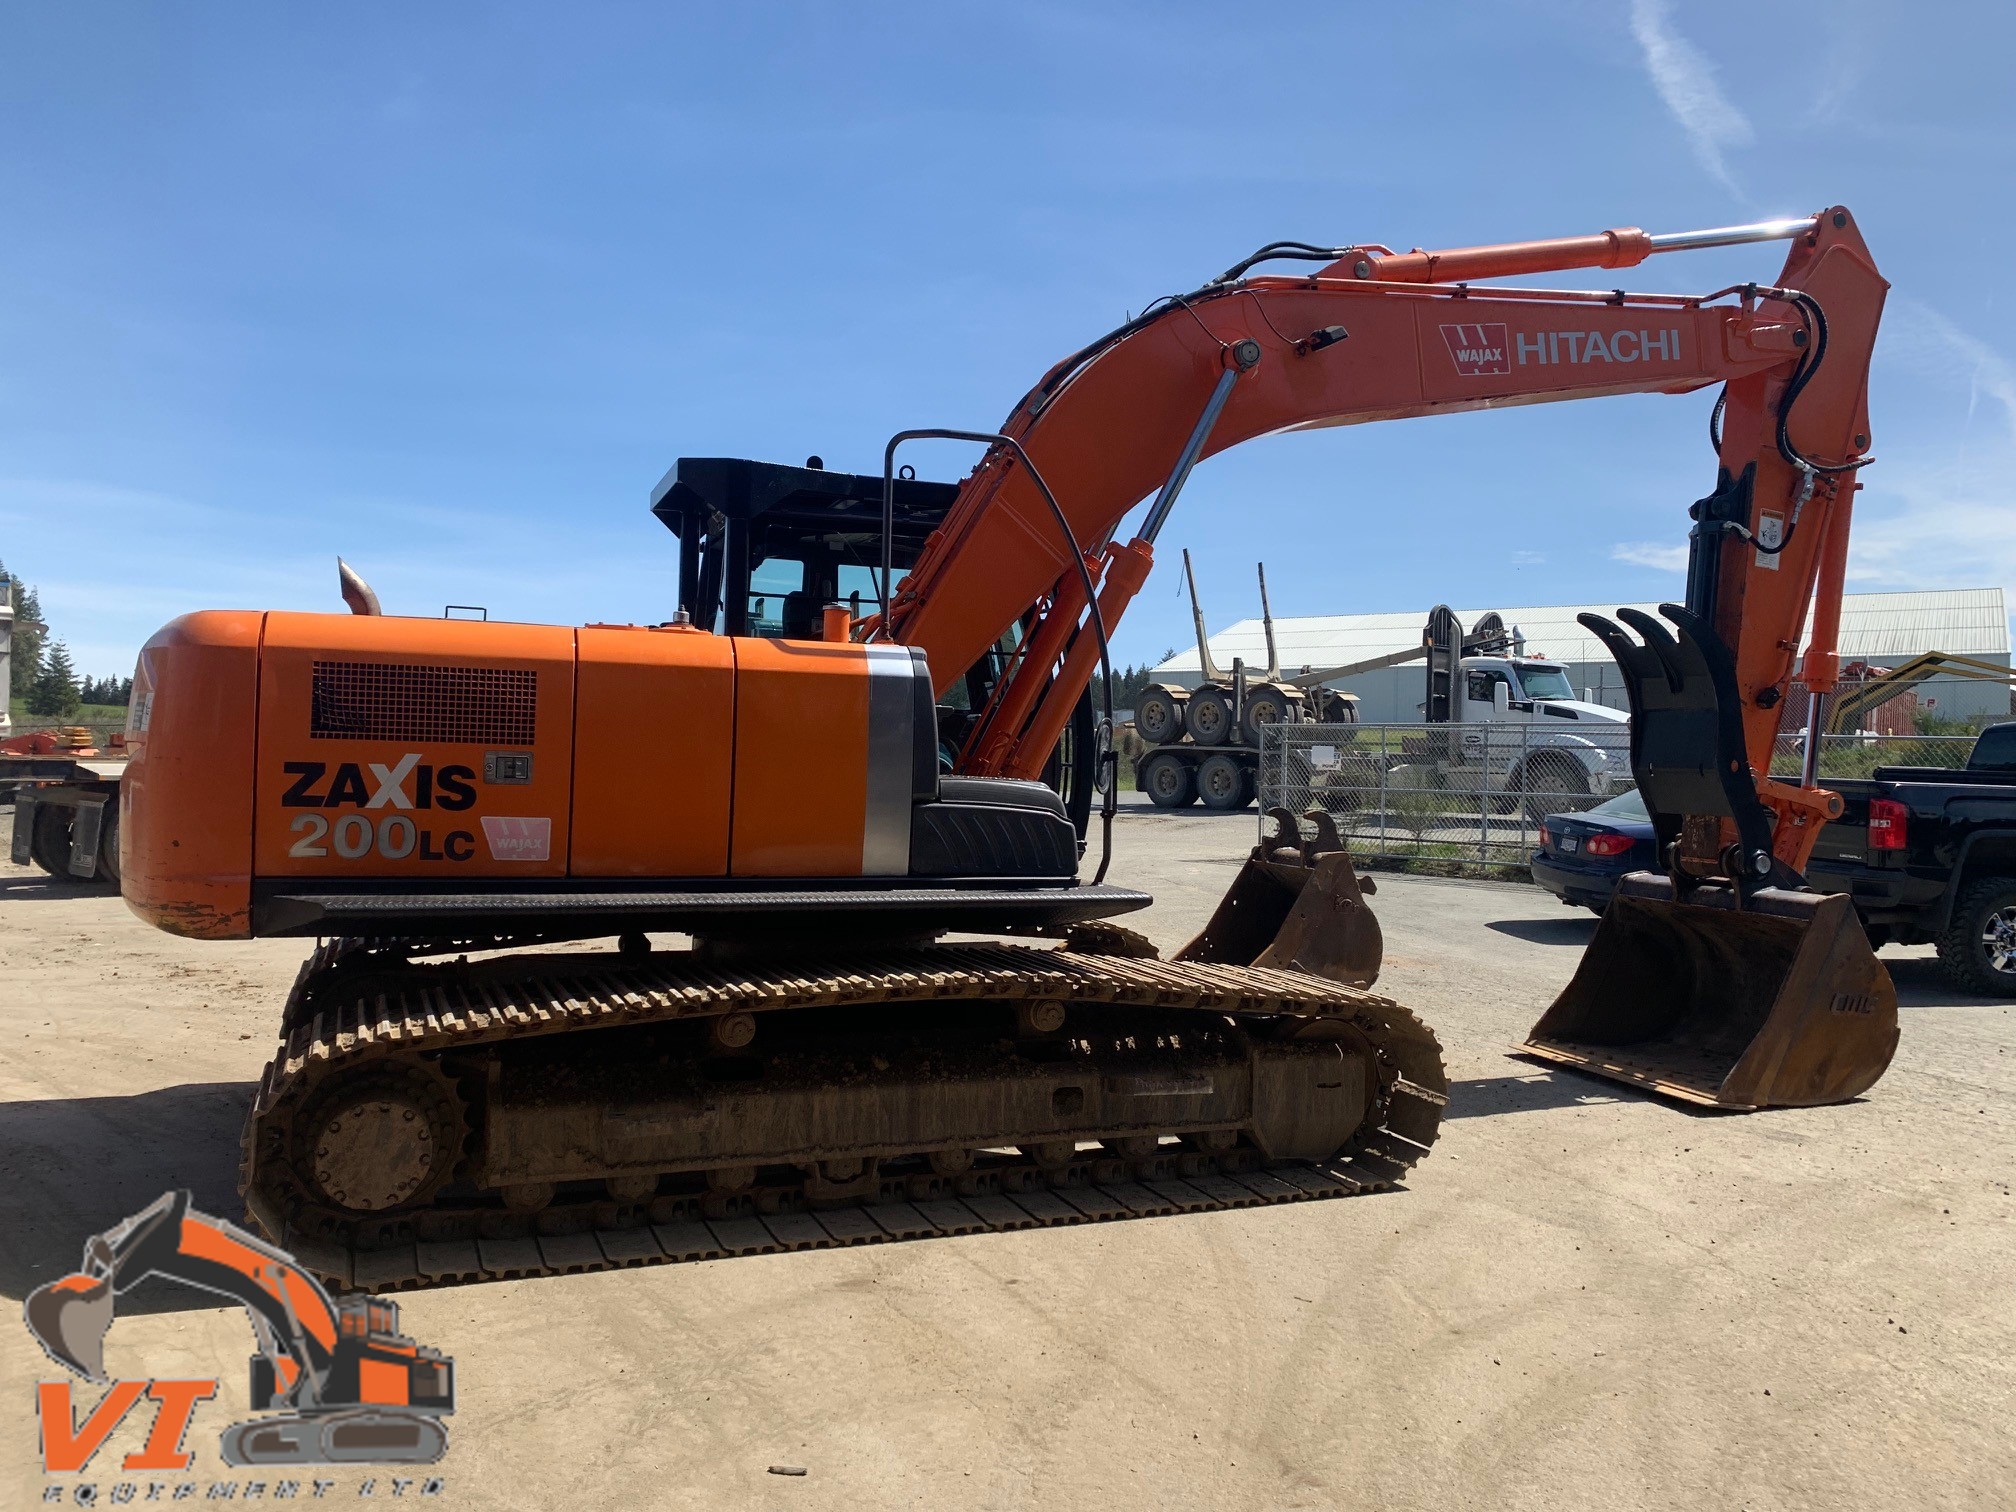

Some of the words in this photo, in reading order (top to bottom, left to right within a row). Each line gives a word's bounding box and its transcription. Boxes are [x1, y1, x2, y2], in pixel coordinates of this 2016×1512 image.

[1457, 348, 1502, 365] WAJAX
[1517, 330, 1680, 364] HITACHI
[281, 753, 478, 812] ZAXIS
[496, 838, 543, 852] WAJAX
